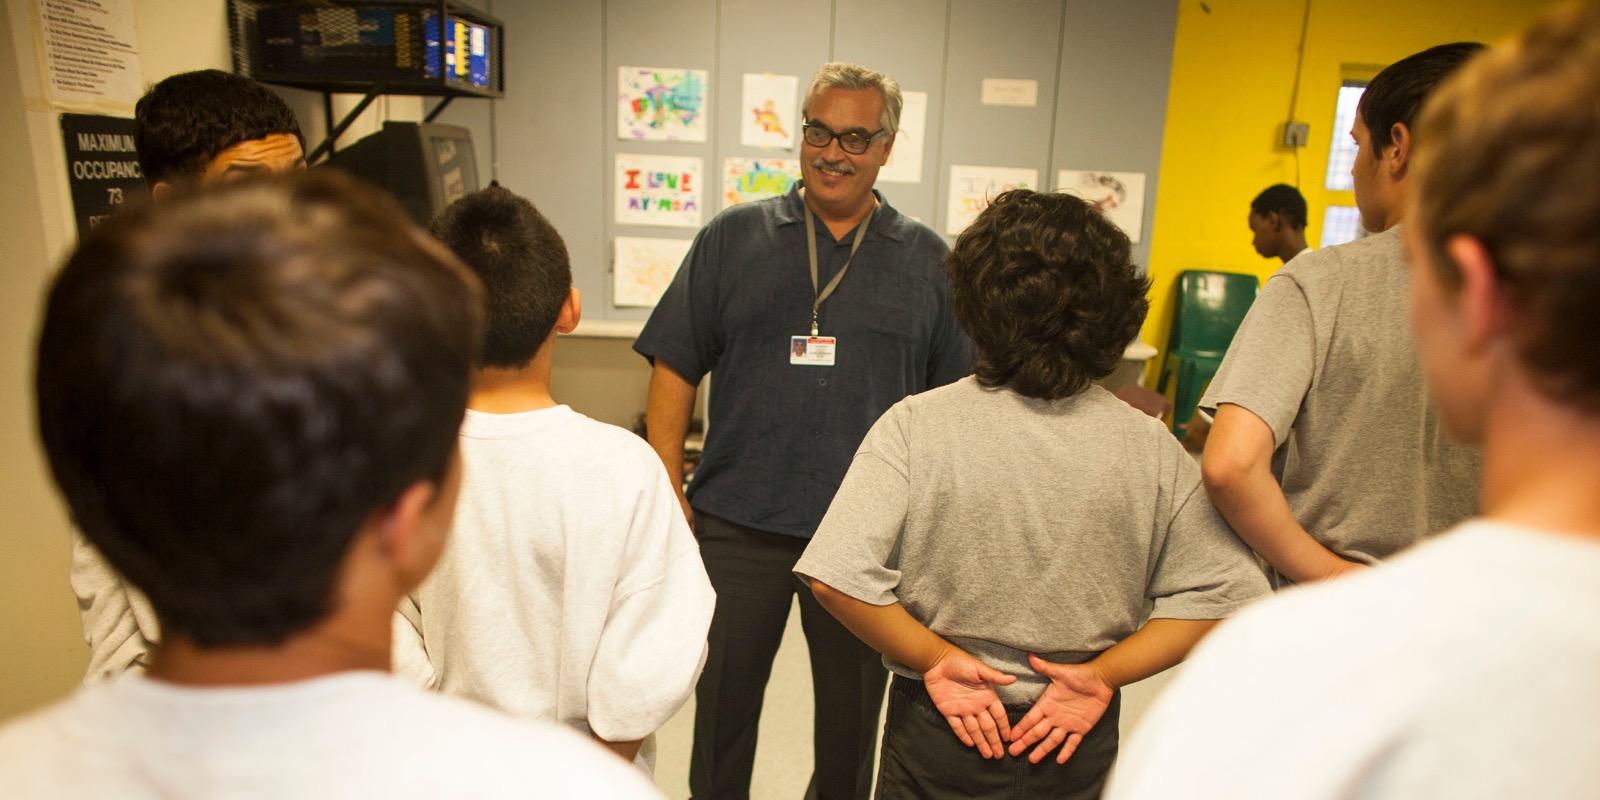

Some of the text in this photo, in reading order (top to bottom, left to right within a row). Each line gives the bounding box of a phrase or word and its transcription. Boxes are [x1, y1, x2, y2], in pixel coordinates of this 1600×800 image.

[73, 161, 142, 179] OCCUPANC
[624, 169, 692, 192] I LOVE
[106, 187, 123, 205] 73
